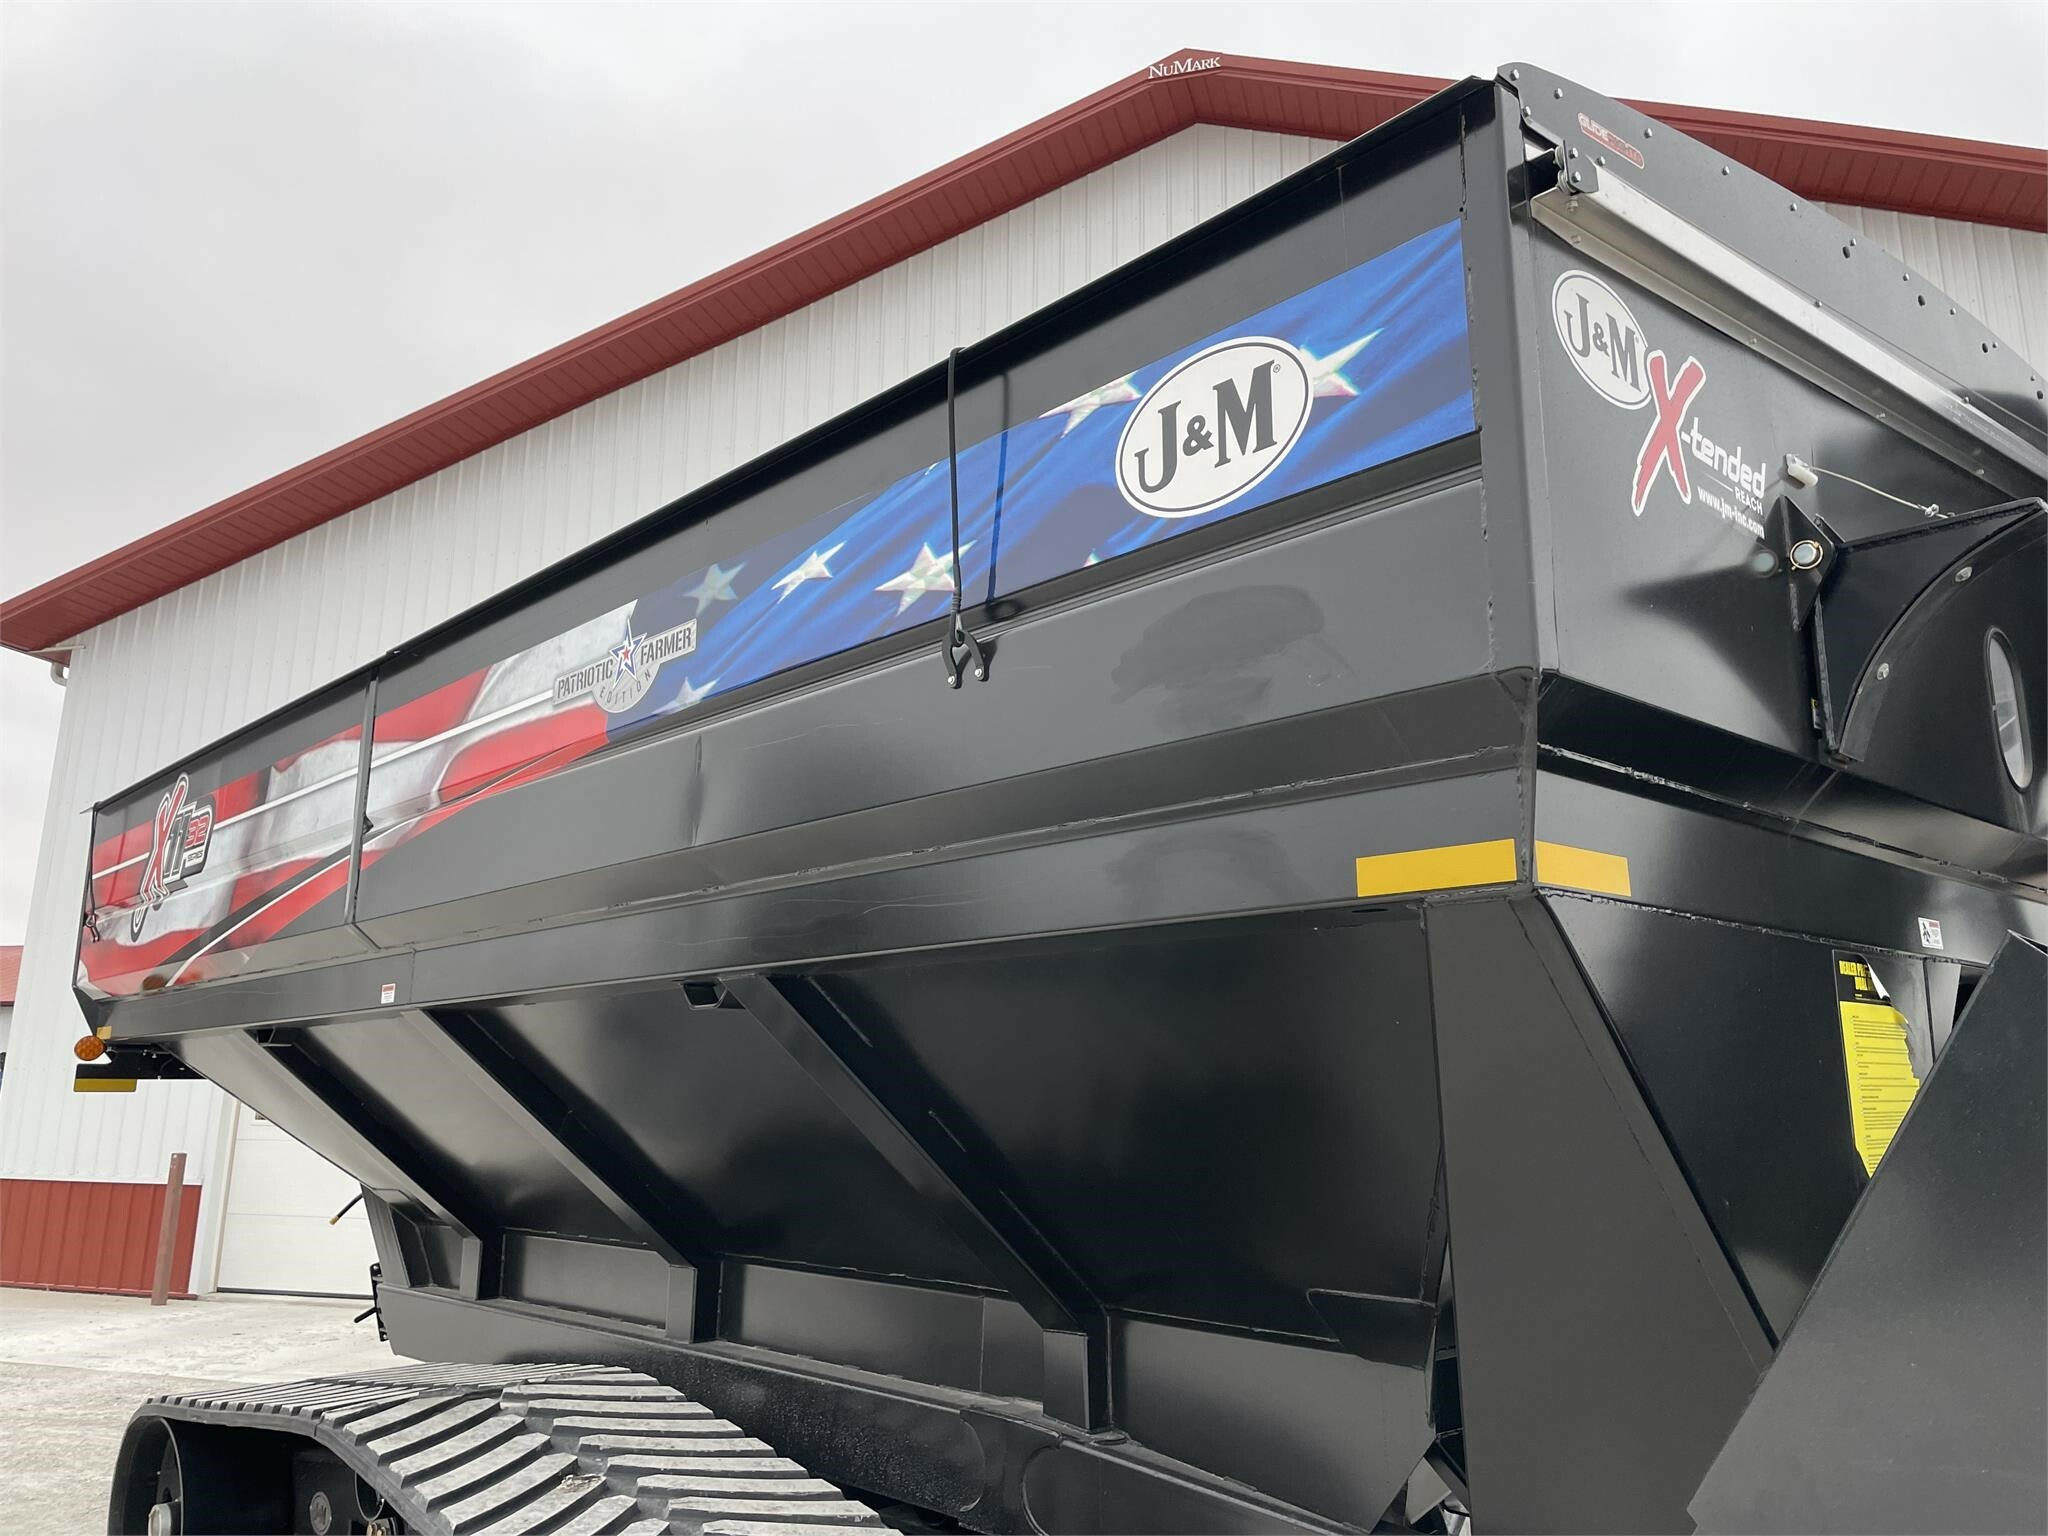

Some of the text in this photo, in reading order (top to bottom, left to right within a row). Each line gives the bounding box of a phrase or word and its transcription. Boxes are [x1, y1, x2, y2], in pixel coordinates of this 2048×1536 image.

[1564, 293, 1641, 392] J&M
[1134, 359, 1278, 494] J&M
[1698, 486, 1765, 539] www.jm-inc.com
[1735, 486, 1763, 515] REACH
[557, 627, 692, 699] PATRIOTIC FARMER
[600, 669, 651, 704] EDITION
